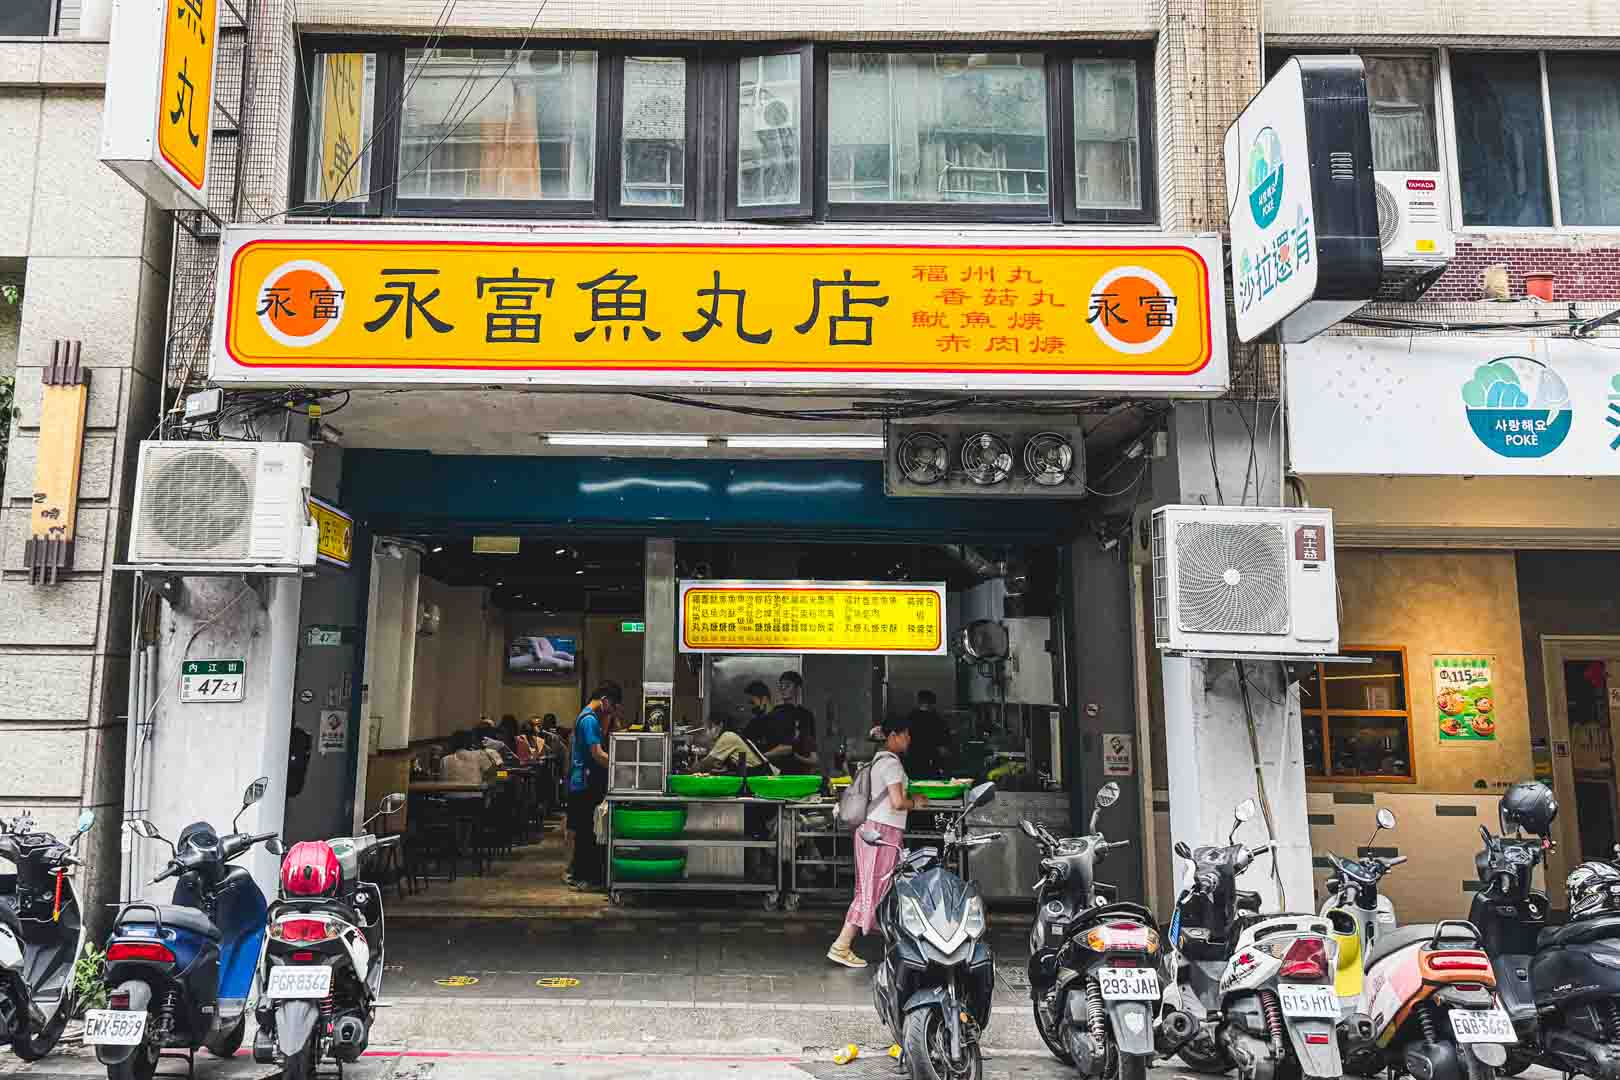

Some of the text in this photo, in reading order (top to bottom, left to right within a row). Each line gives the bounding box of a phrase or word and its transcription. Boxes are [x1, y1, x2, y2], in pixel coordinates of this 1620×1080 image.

[1408, 181, 1434, 189] YAMADA
[912, 264, 1043, 284] 福州丸
[256, 288, 345, 319] 永富
[364, 267, 889, 345] 永富魚丸店
[935, 287, 1065, 308] 香菇丸
[1086, 292, 1178, 328] 永富
[1495, 419, 1548, 432] 사랑해요
